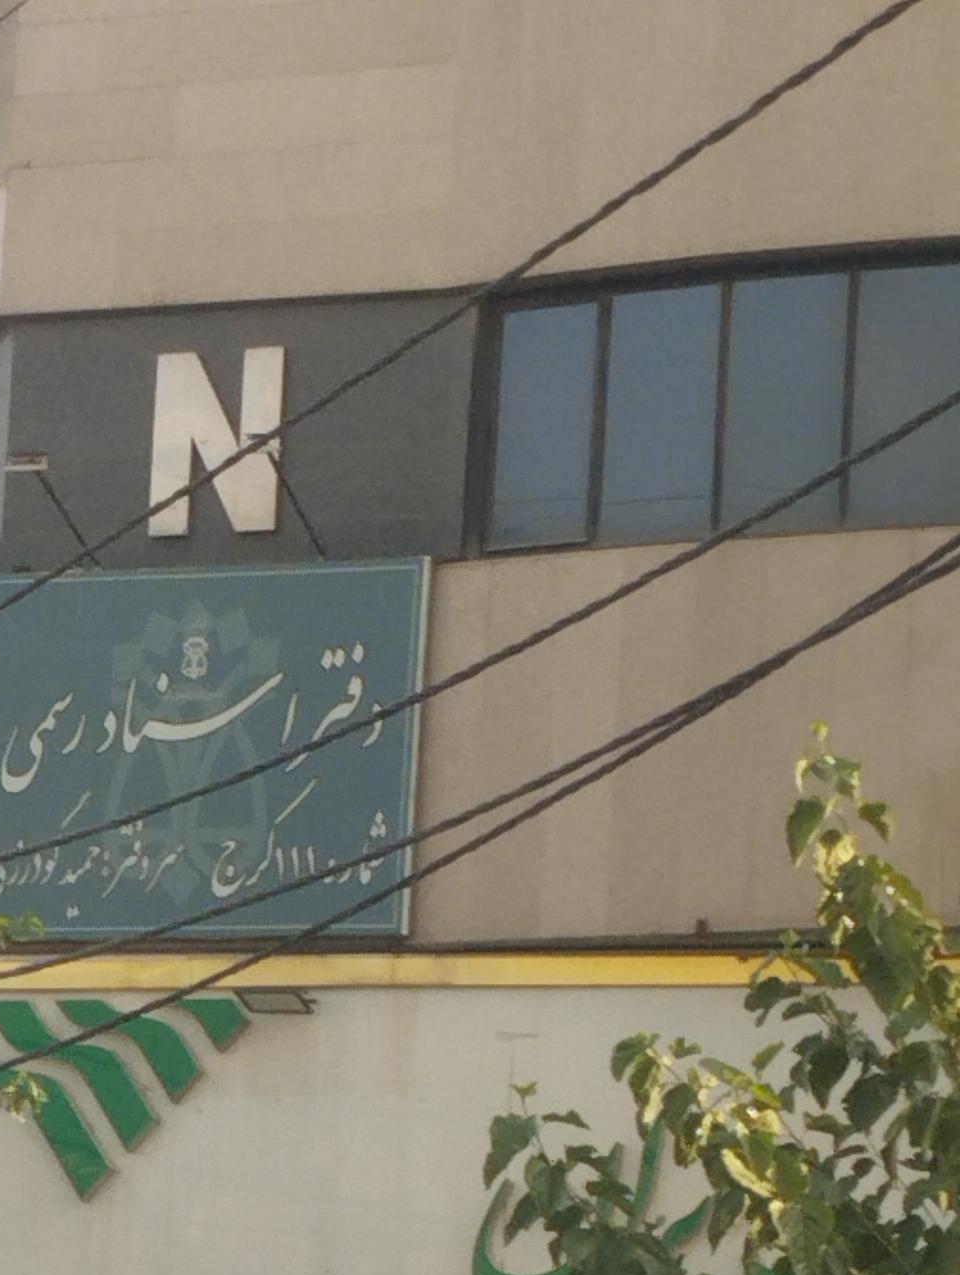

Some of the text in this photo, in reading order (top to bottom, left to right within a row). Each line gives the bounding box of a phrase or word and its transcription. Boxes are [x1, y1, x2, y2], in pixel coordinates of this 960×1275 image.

[148, 346, 285, 537] N
[0, 641, 384, 793] دفتر اسناد رسمی
[211, 777, 321, 898] کرج
